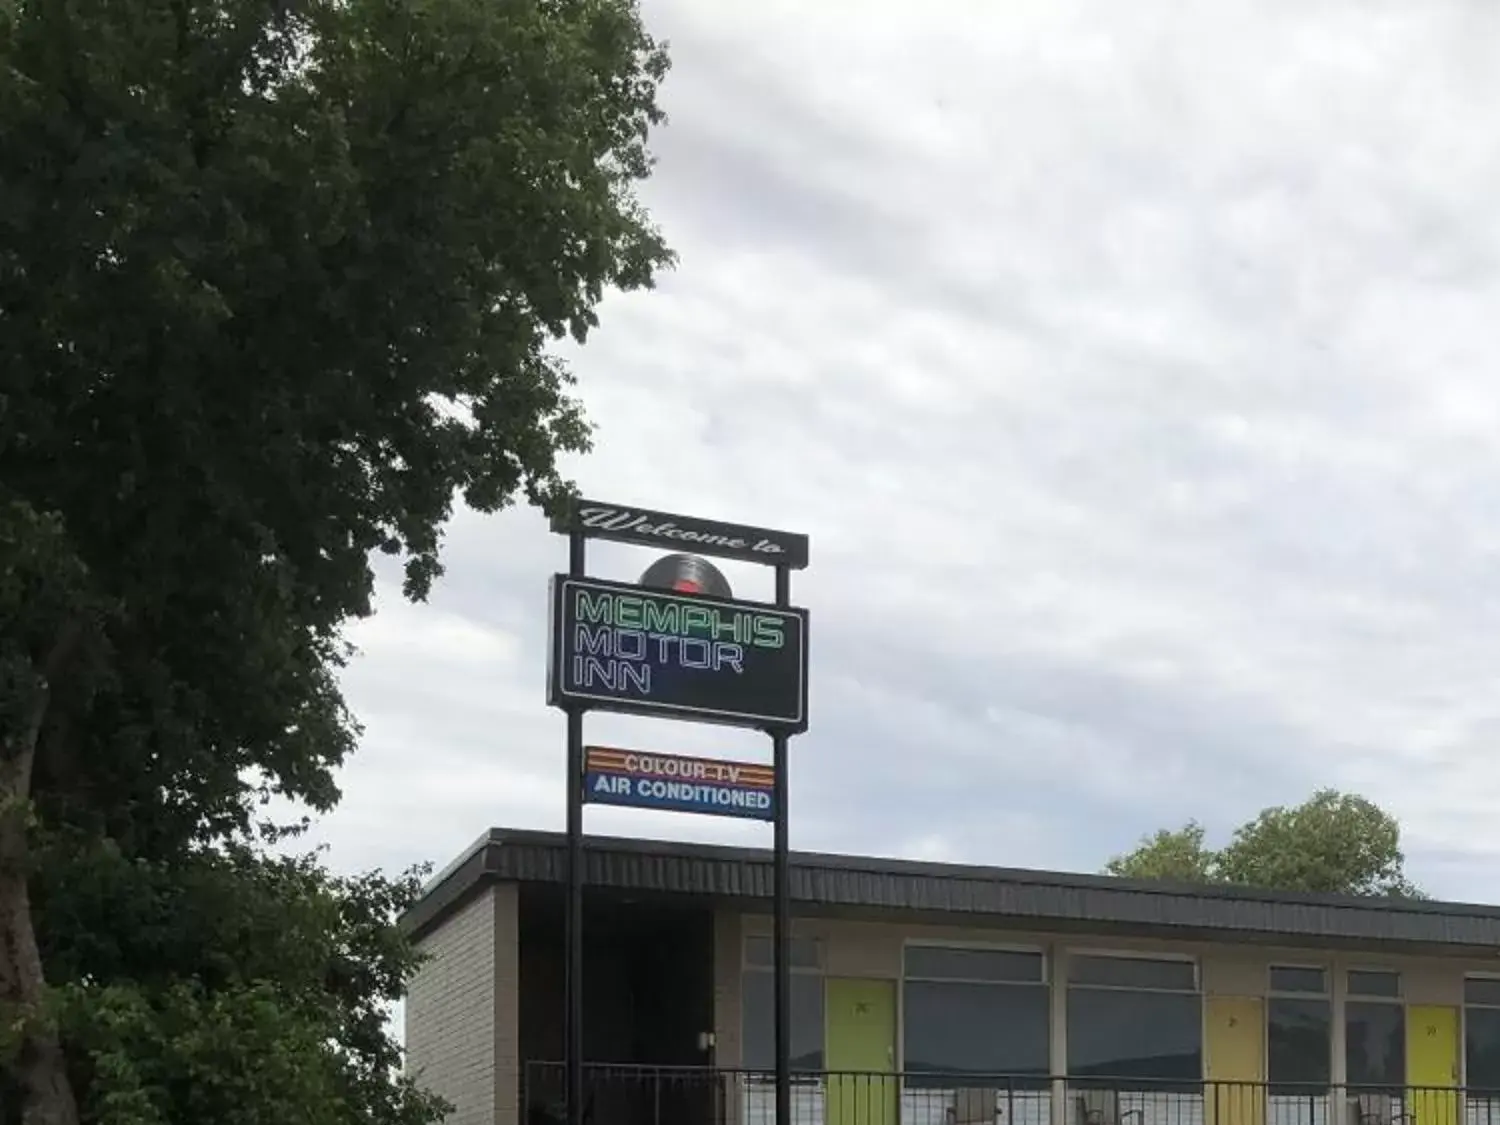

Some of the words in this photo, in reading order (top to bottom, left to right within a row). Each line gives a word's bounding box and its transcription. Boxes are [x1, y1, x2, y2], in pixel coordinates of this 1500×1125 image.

[579, 507, 745, 549] Welcome
[752, 538, 785, 553] to
[576, 590, 784, 648] MEMPHIS
[575, 623, 744, 673] MOTOR
[574, 654, 650, 694] INN
[624, 755, 706, 779] COLOUR
[716, 767, 741, 782] TV
[595, 776, 631, 796] AIR
[637, 779, 770, 809] CONDITIONED
